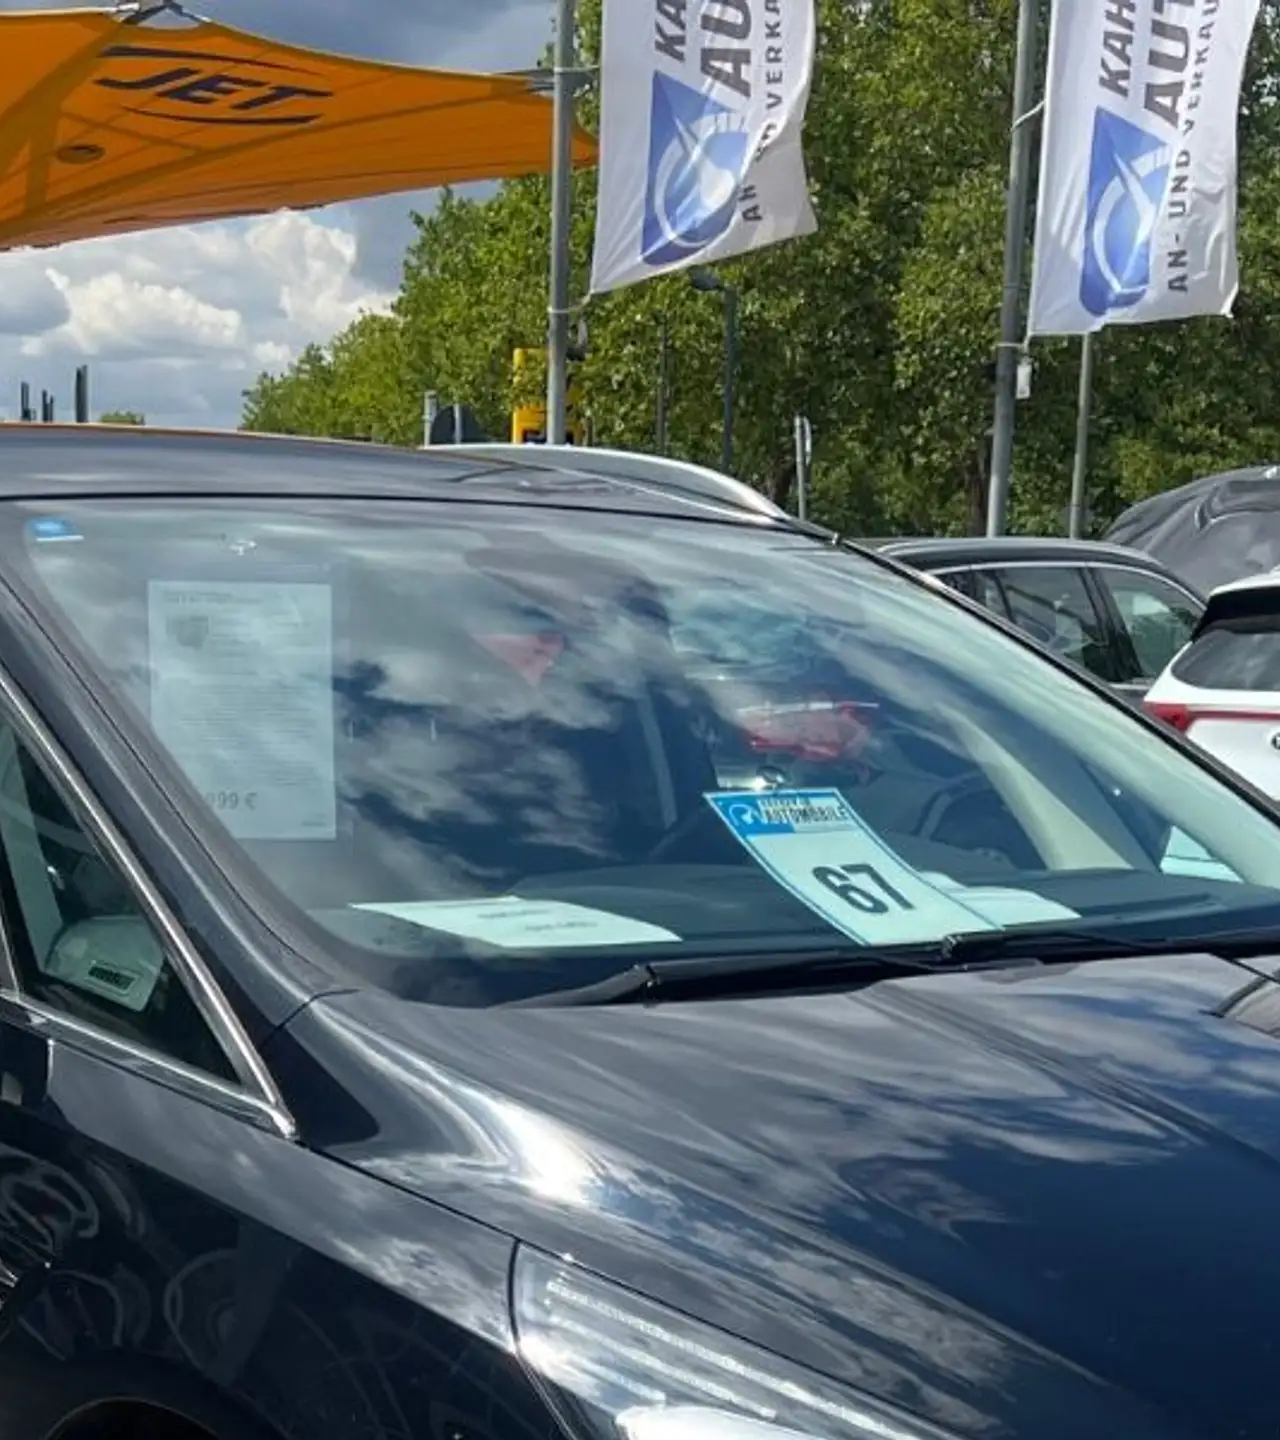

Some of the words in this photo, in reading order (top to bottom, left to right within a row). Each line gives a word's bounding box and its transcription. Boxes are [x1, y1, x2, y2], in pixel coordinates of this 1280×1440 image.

[94, 67, 334, 110] JET
[1169, 149, 1191, 219] UND
[812, 863, 916, 914] 67
